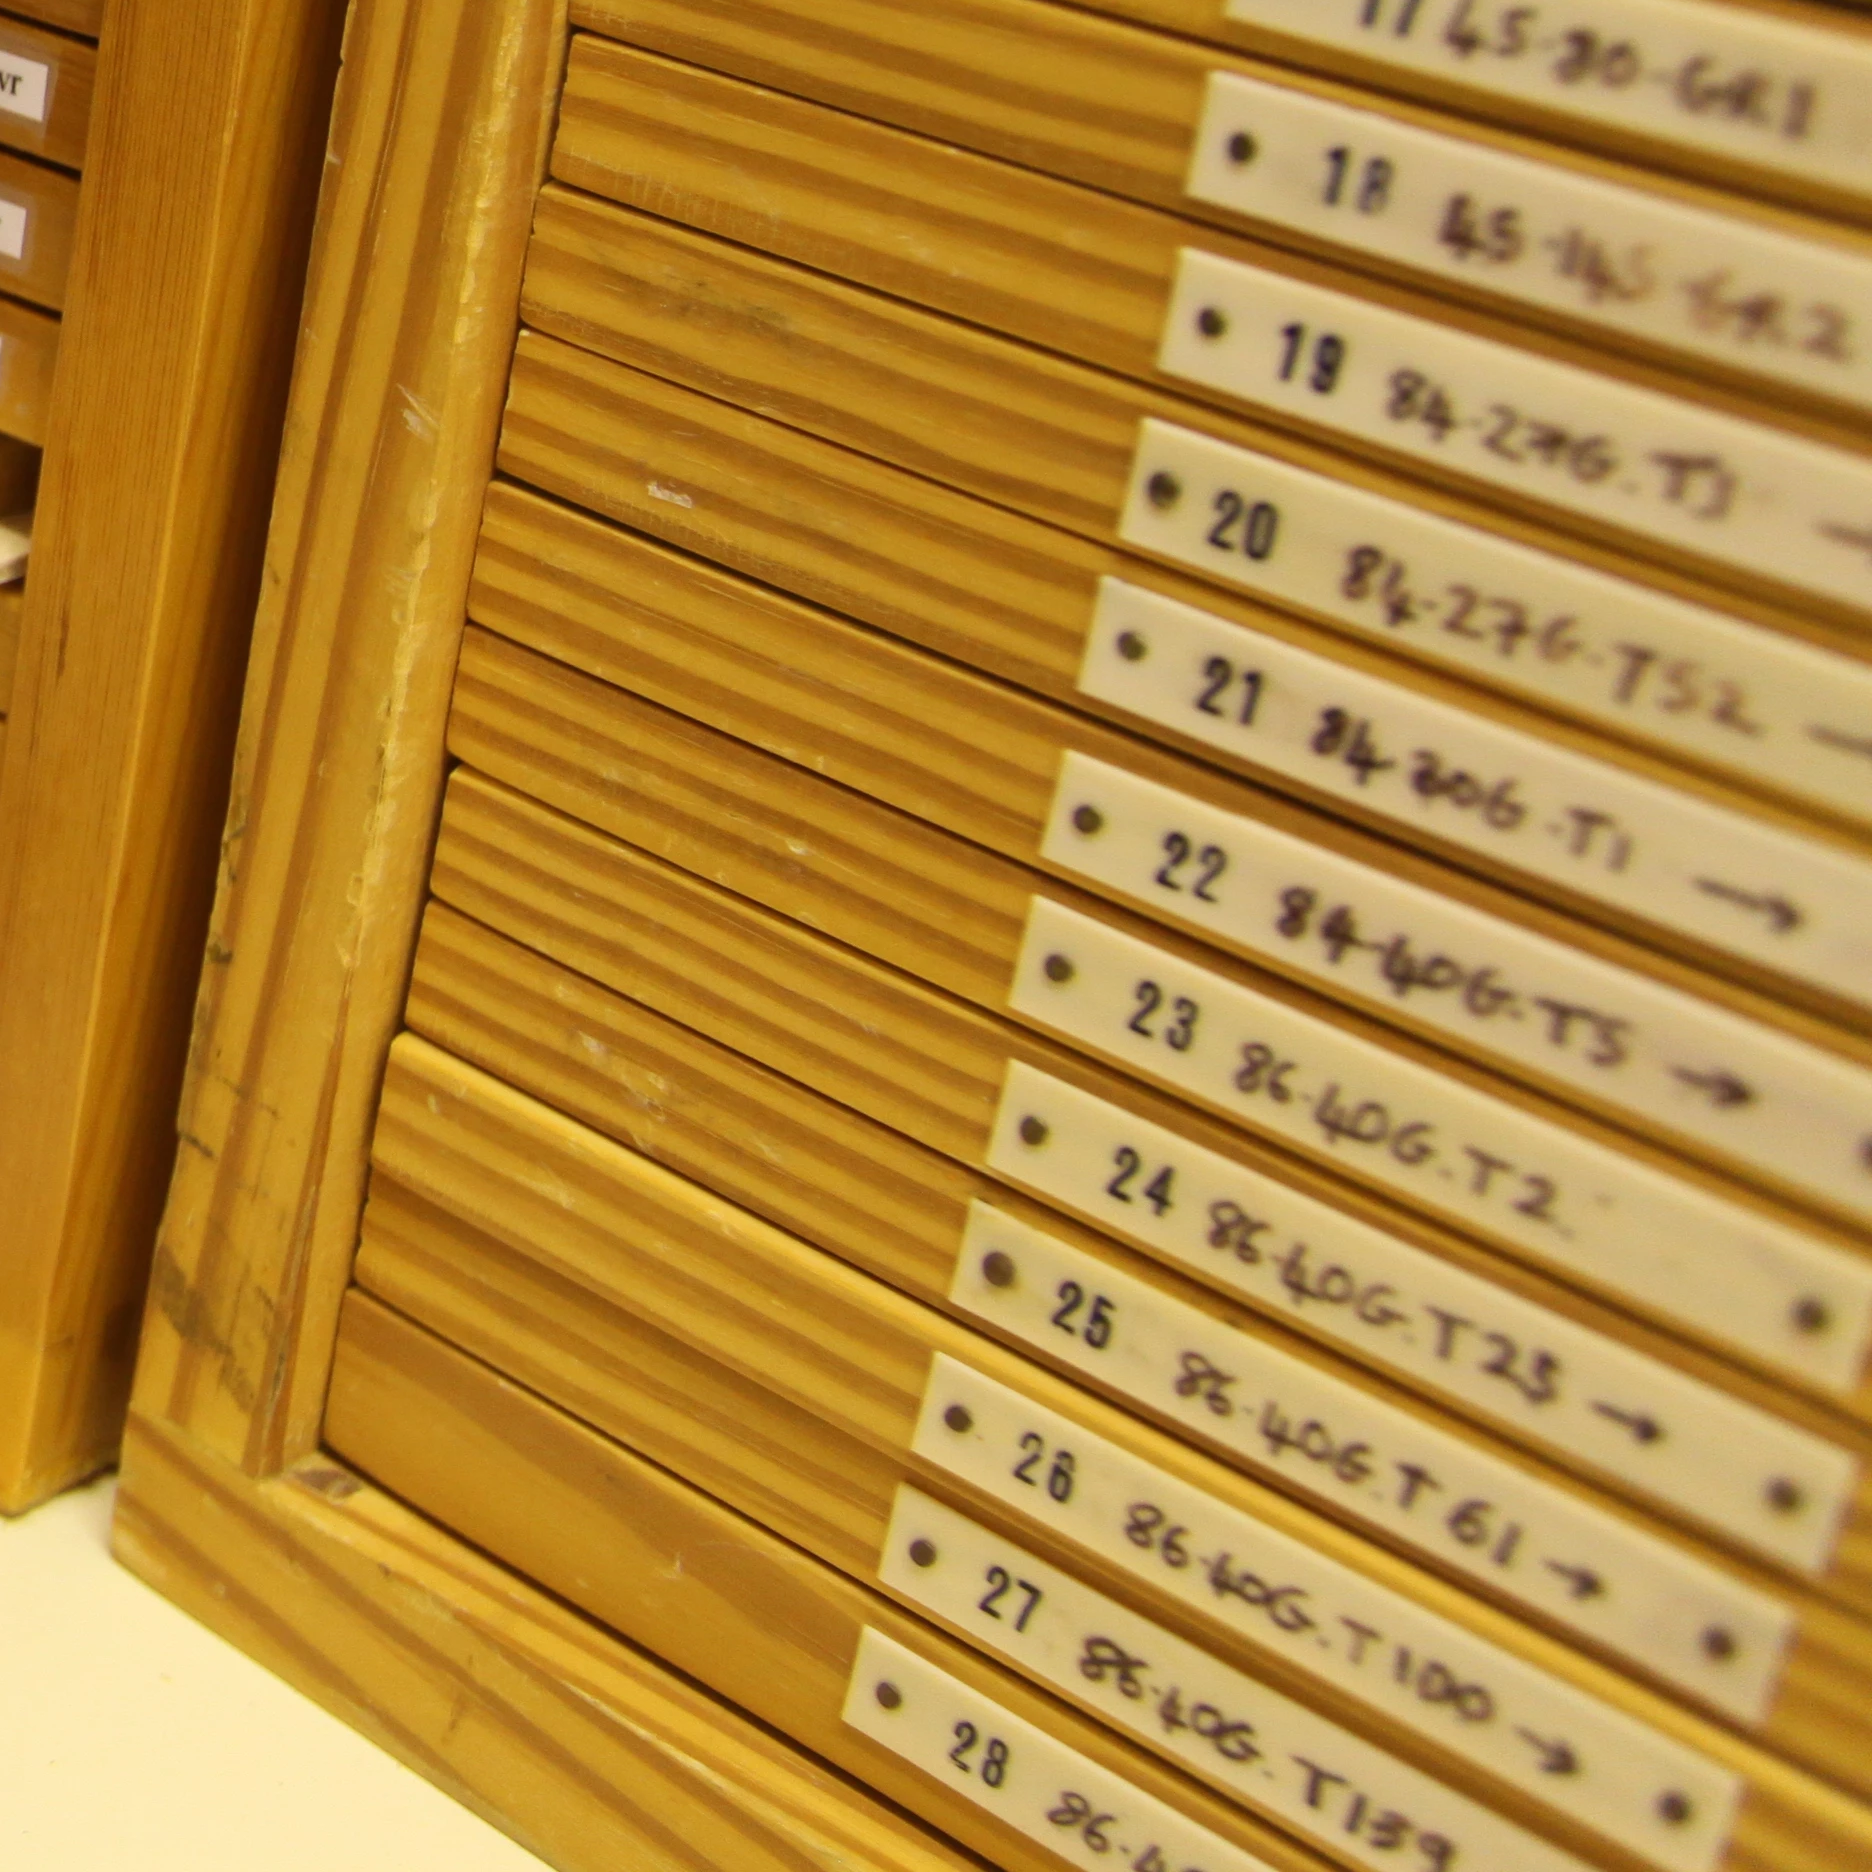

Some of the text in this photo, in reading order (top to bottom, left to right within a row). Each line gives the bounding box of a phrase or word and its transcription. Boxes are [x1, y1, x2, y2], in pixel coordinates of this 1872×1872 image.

[1325, 145, 1394, 215] 18
[1280, 322, 1343, 394] 19
[1206, 488, 1279, 562] 20
[1195, 656, 1265, 728] 21
[1154, 831, 1227, 904] 22
[1126, 980, 1200, 1053] 23
[1104, 1145, 1174, 1217] 24
[1051, 1282, 1115, 1352] 25
[1012, 1431, 1078, 1505] 26
[977, 1565, 1043, 1633] 27
[948, 1719, 1012, 1791] 28
